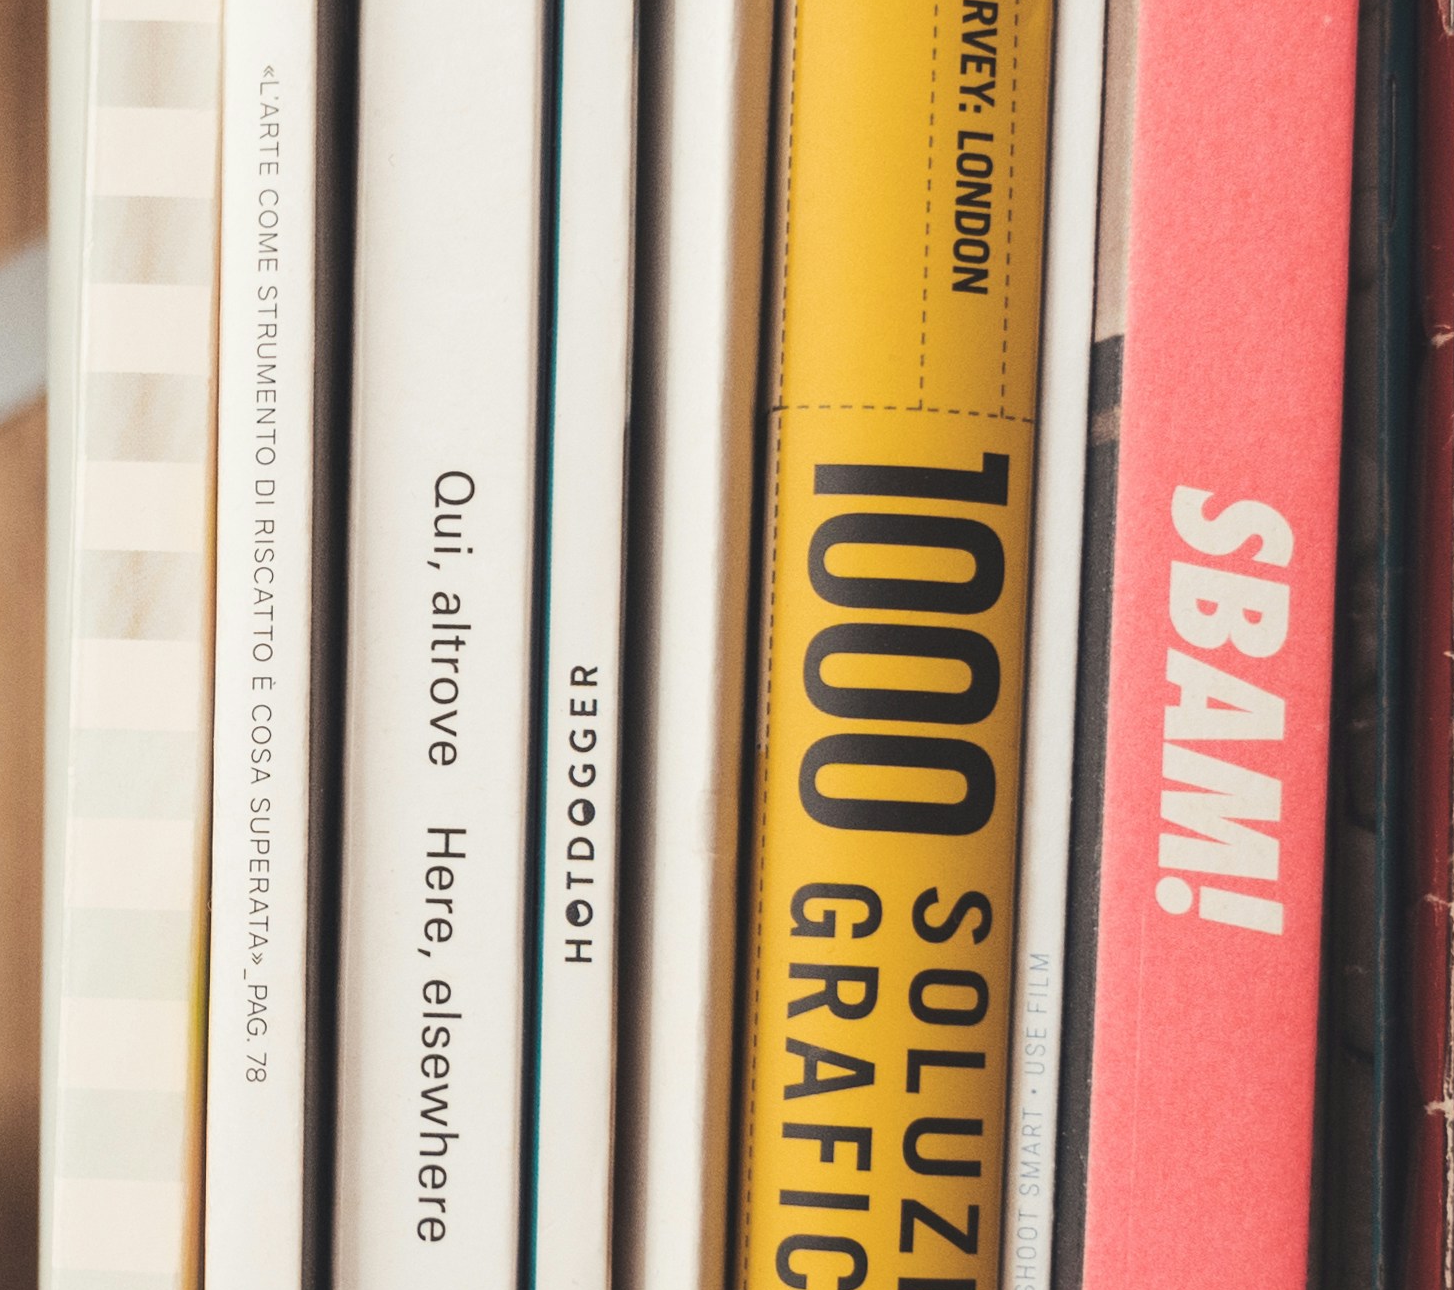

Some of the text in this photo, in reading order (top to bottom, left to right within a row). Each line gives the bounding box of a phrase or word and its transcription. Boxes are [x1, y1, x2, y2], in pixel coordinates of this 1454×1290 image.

[256, 188, 280, 272] COME
[951, 131, 995, 297] LONDON
[254, 284, 278, 466] STRUMENTO
[253, 478, 276, 505] DI
[251, 518, 275, 663] RISCATTO
[250, 675, 276, 691] È
[799, 452, 1011, 836] 1000
[249, 703, 273, 785] COSA
[1155, 484, 1294, 934] SBAM!
[415, 470, 476, 1242] Qui, altrove Here, elsewhere
[563, 664, 599, 963] HOTDOGGER
[1025, 952, 1049, 1014] FILM
[244, 1051, 268, 1083] 78
[1024, 1027, 1047, 1075] USE
[1017, 1107, 1042, 1196] SMART
